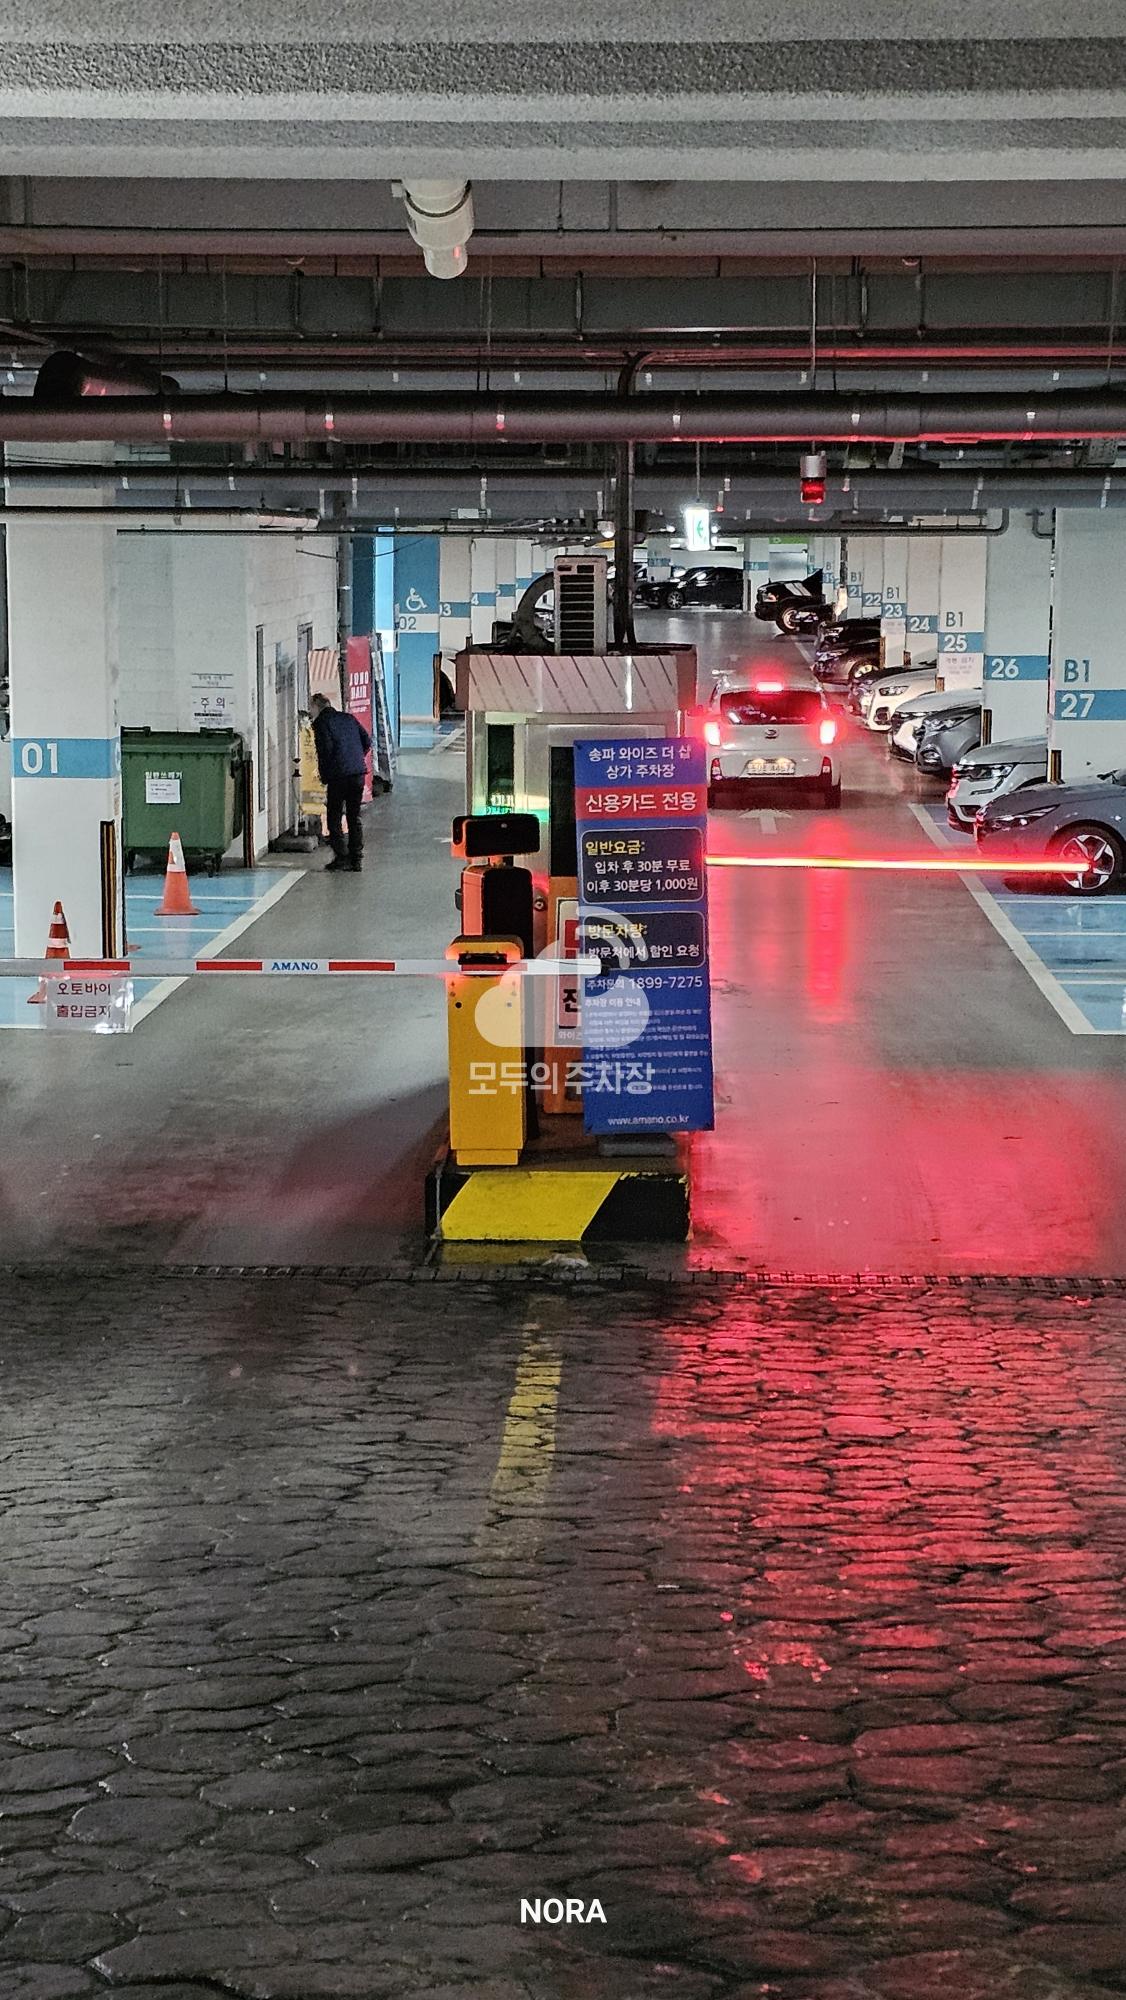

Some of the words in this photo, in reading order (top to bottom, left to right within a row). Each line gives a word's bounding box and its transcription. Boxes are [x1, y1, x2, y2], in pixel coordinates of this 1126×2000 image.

[850, 572, 862, 582] B1
[849, 586, 862, 597] 21
[886, 587, 900, 599] B1
[865, 594, 881, 606] 22
[884, 604, 903, 618] 23
[909, 617, 931, 632] 24
[945, 611, 964, 627] B1
[943, 634, 968, 652] 25
[991, 658, 1019, 678] 26
[1063, 659, 1090, 683] B1
[1060, 693, 1095, 718] 27
[21, 742, 58, 774] 01
[588, 747, 616, 762] 송파
[618, 746, 659, 762] 와이즈
[662, 746, 675, 760] 더
[606, 765, 632, 780] 상가
[636, 763, 675, 779] 주차장
[585, 793, 657, 813] 신용카드
[662, 791, 697, 811] 전용
[594, 861, 620, 875] 입차
[622, 860, 635, 873] 후
[637, 860, 664, 874] 30분
[666, 859, 691, 873] 무료
[586, 879, 610, 894] 이후
[613, 879, 652, 893] 30분당
[655, 877, 699, 892] 1,000원
[676, 944, 700, 957] 요청
[271, 962, 319, 971] AMANO
[56, 981, 112, 996] 오토바이
[628, 975, 704, 990] 1899-7275
[56, 1004, 112, 1018] 출입금지
[607, 1114, 690, 1126] www.amano.co.kr
